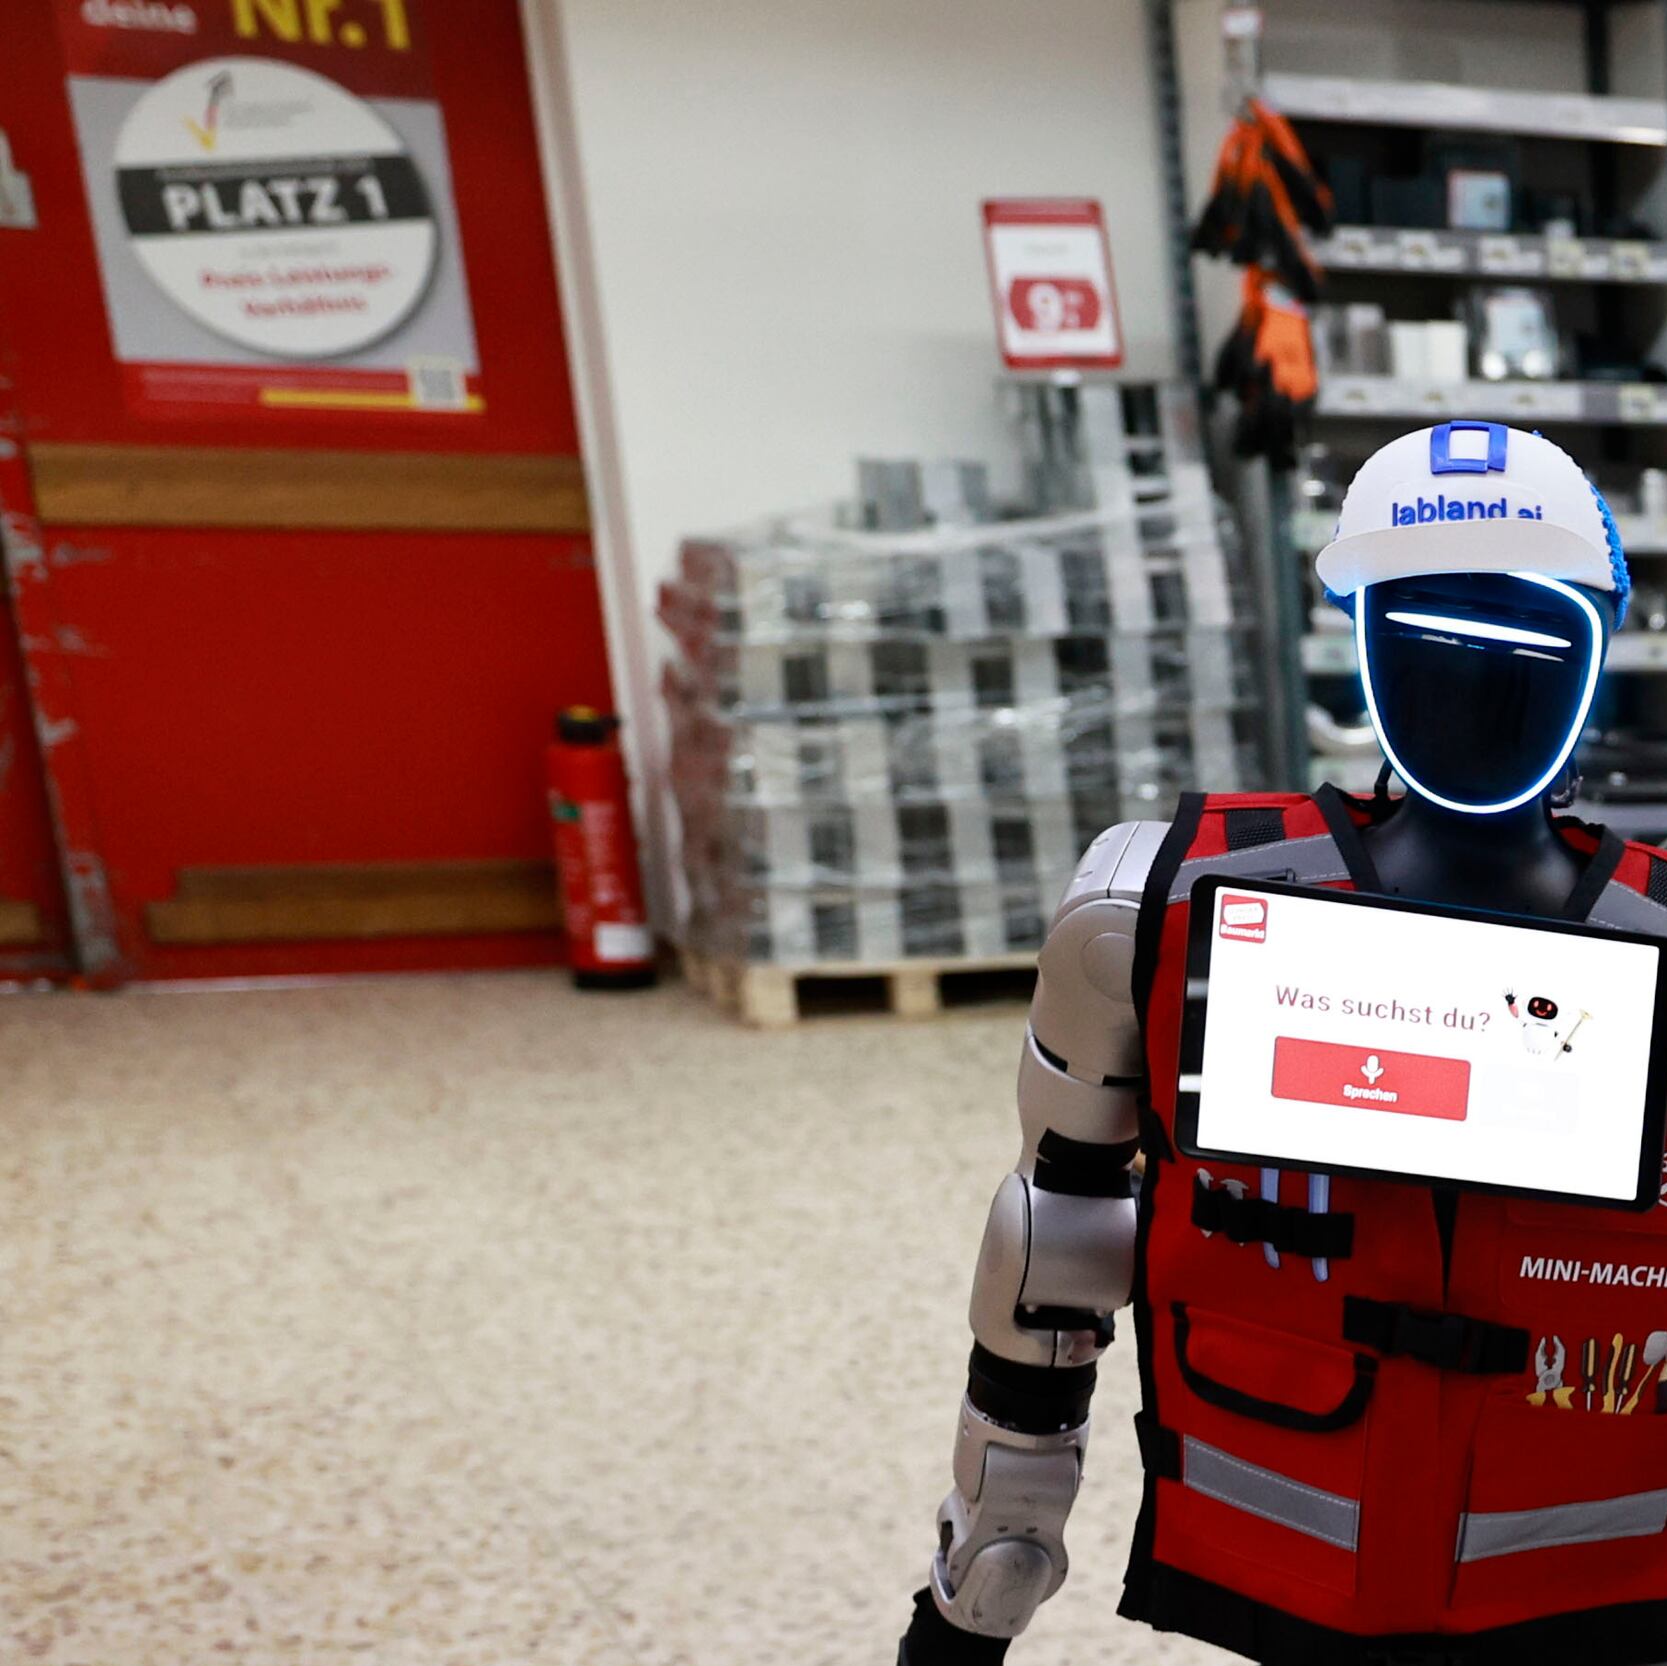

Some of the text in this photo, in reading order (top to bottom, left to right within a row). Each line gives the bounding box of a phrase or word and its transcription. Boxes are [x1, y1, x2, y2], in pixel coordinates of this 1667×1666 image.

[162, 174, 390, 232] PLATZ 1
[1275, 983, 1491, 1032] Was suchst du?
[1342, 1083, 1399, 1103] Sprechen
